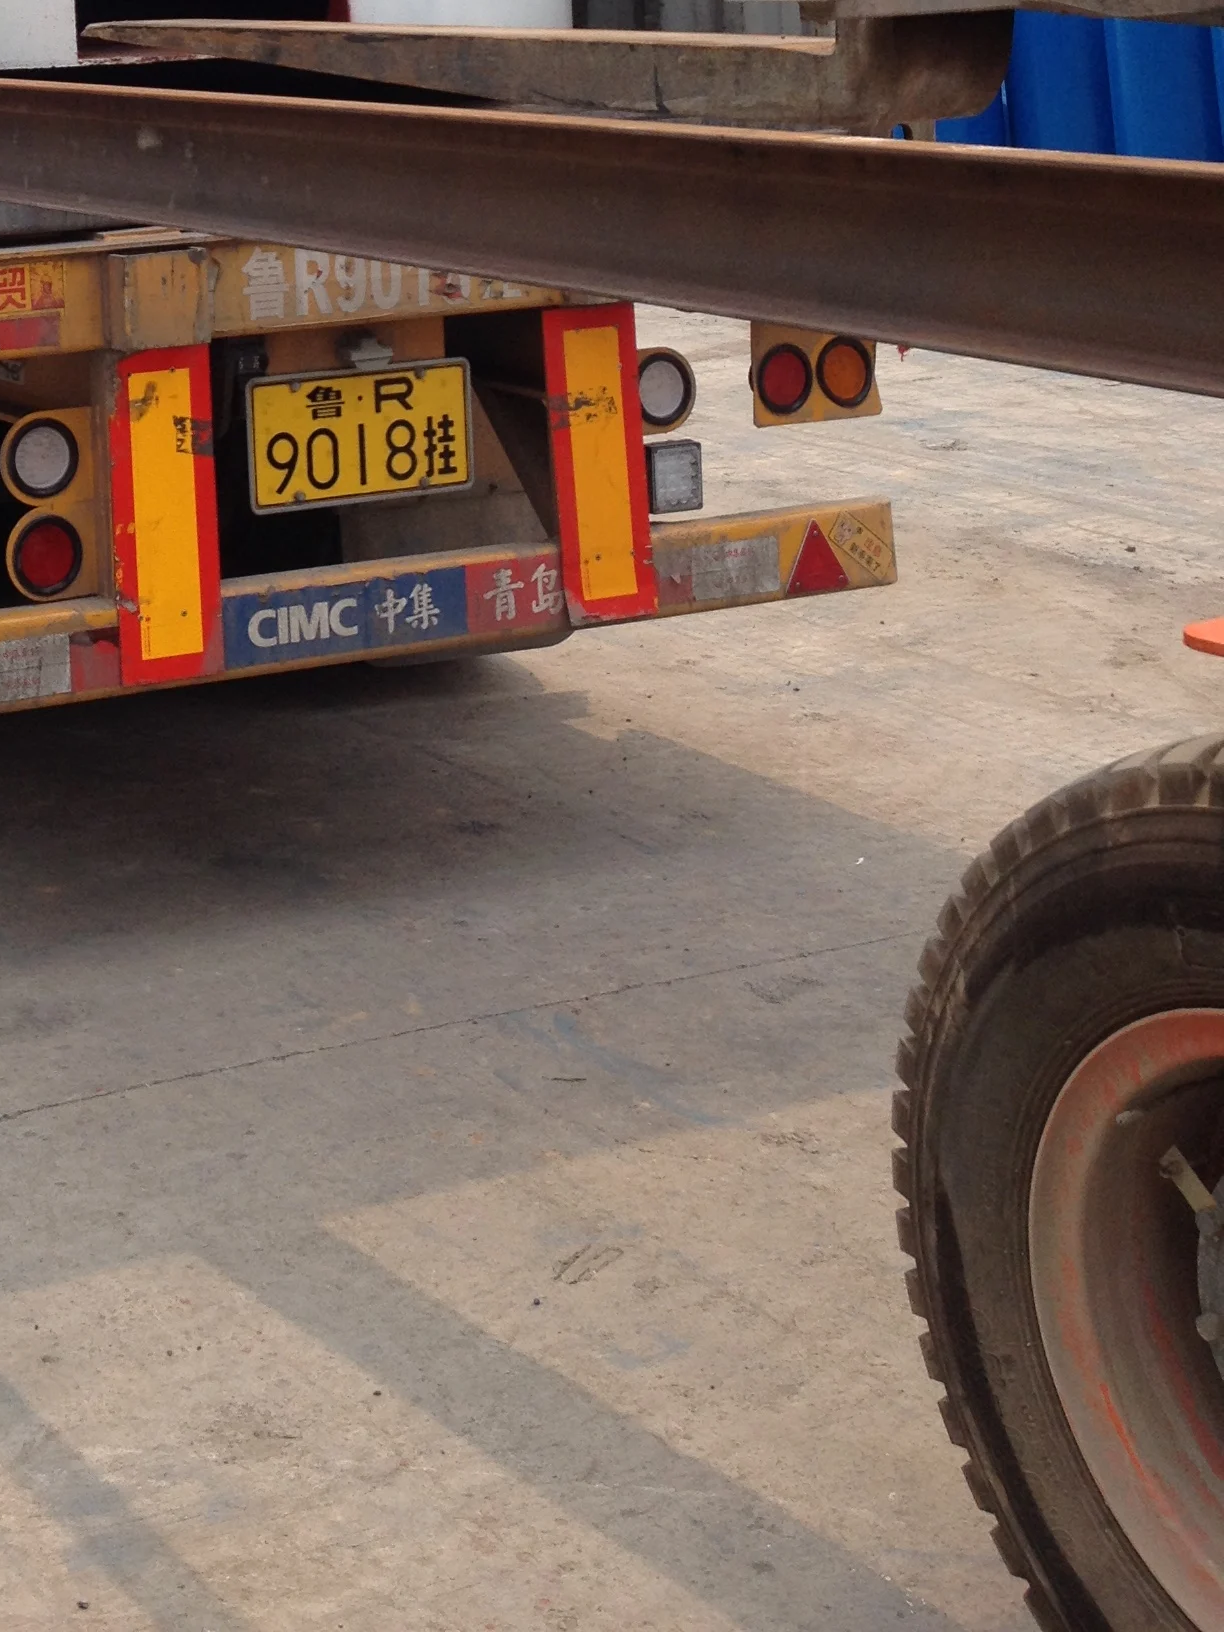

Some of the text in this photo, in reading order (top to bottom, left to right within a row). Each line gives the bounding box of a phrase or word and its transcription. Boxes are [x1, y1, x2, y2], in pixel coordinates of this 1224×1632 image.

[266, 413, 458, 495] 9018挂
[247, 598, 359, 648] CIMC
[374, 583, 441, 635] 中集
